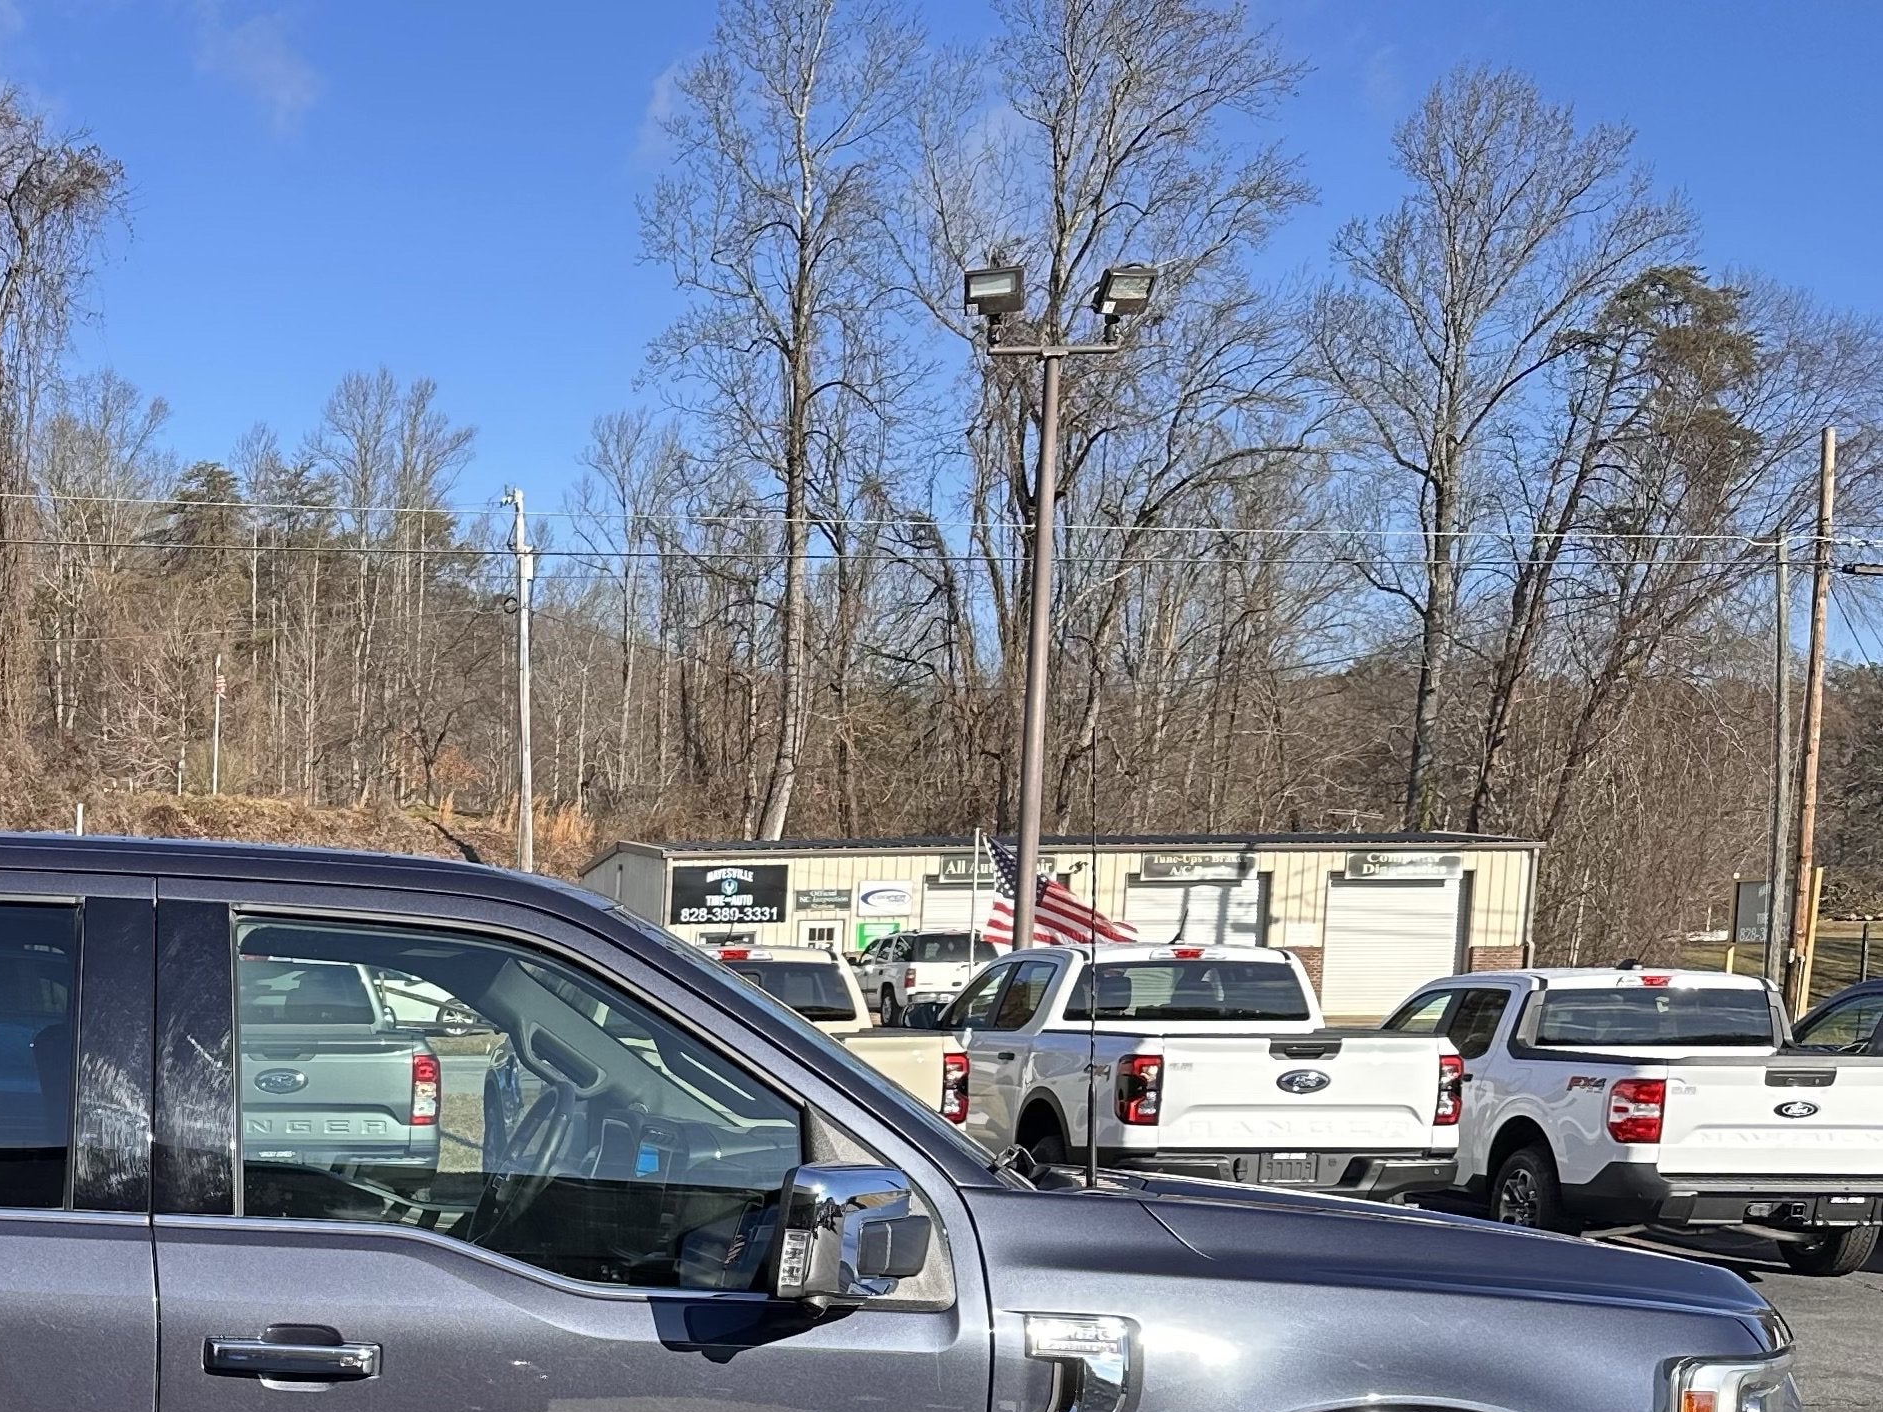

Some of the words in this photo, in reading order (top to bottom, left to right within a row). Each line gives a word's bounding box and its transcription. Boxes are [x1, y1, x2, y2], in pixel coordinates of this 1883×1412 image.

[945, 860, 965, 874] All
[968, 862, 995, 874] Aut
[706, 868, 754, 883] HAYESVILLE
[706, 895, 725, 906] TIRE
[731, 895, 754, 906] AUTO
[246, 1120, 387, 1134] NGER
